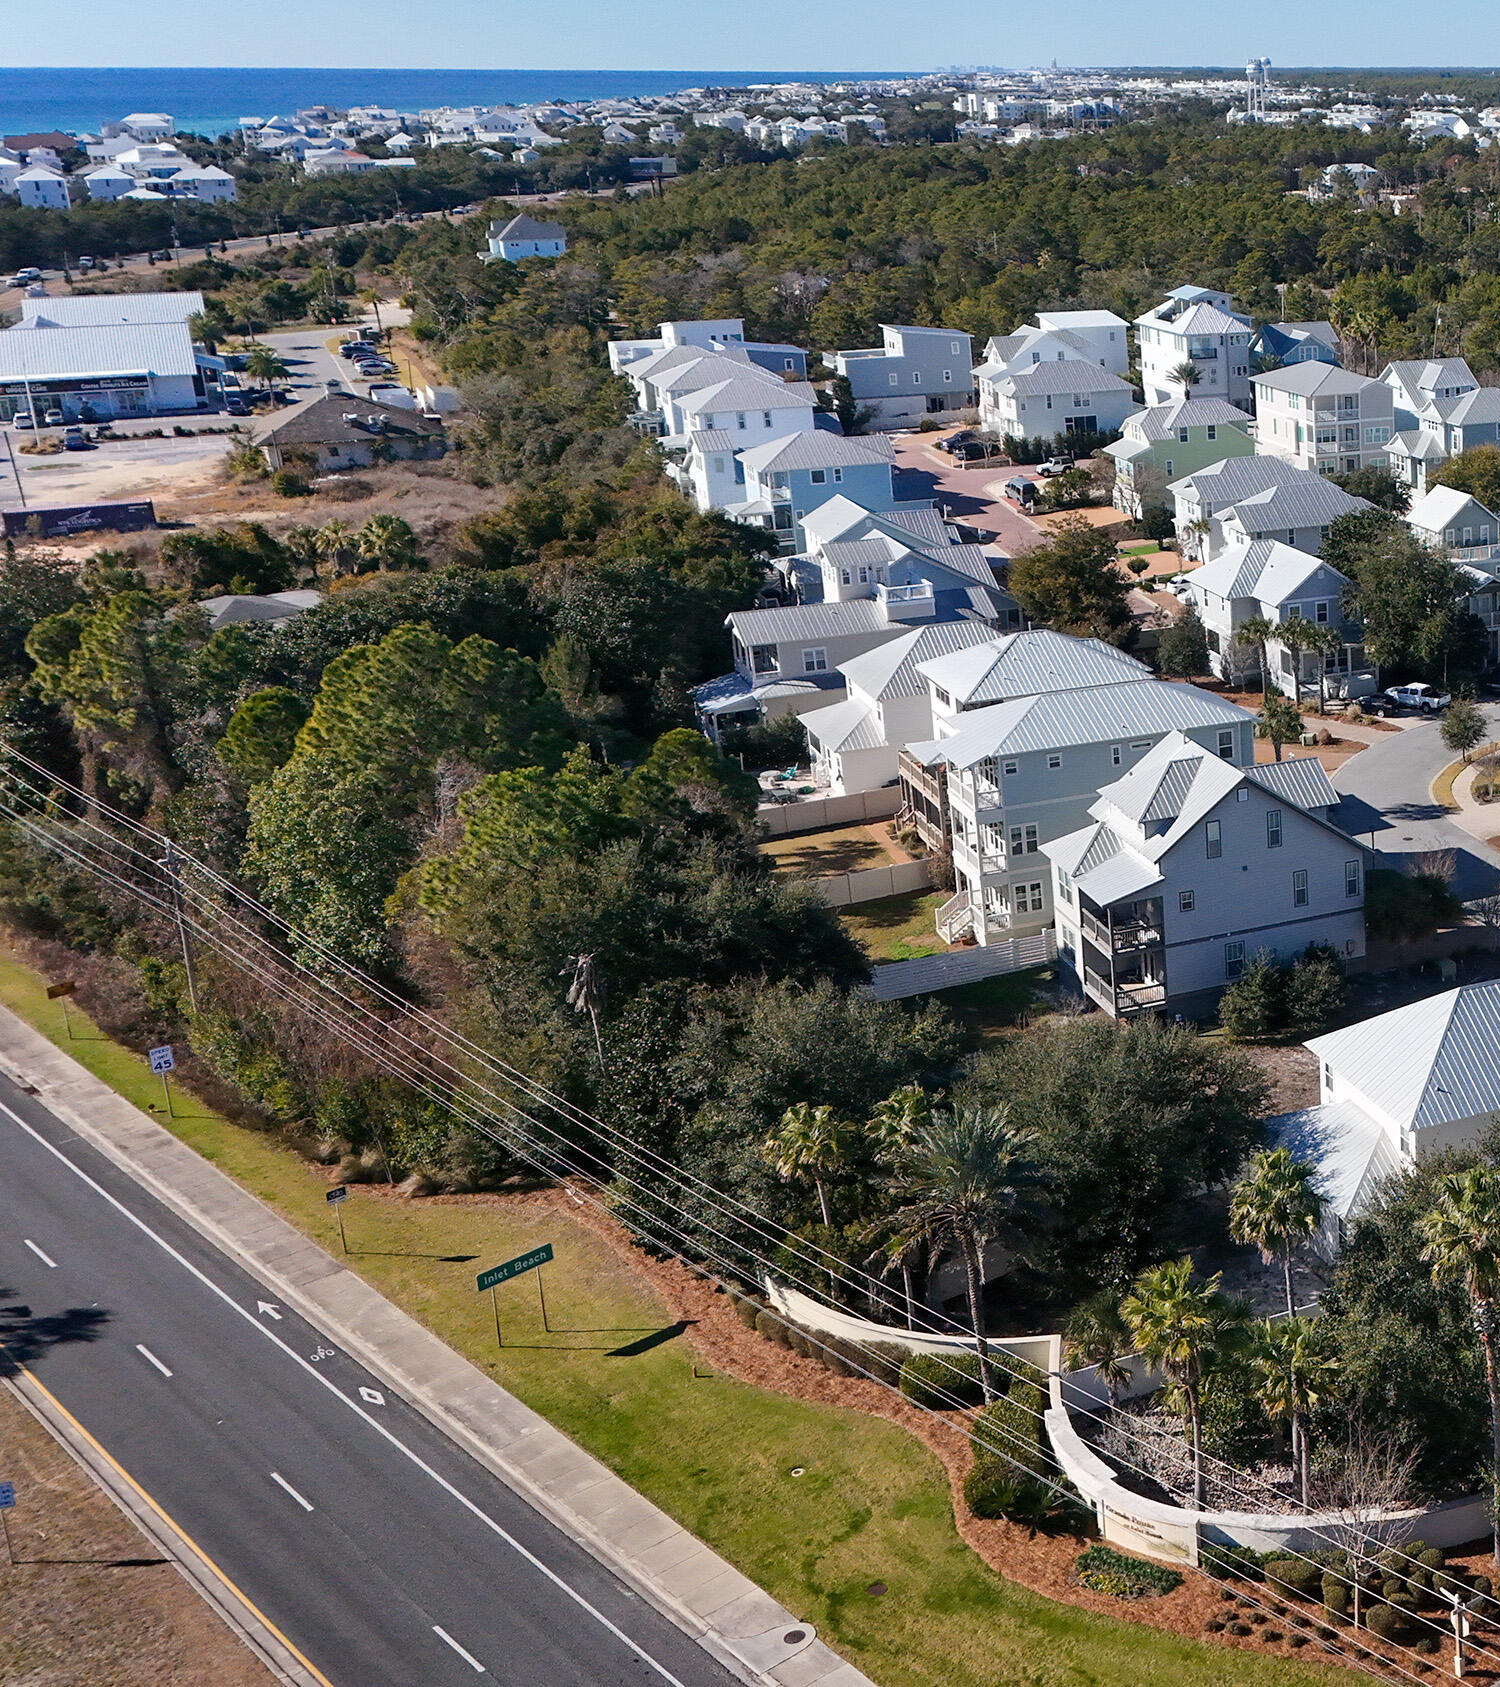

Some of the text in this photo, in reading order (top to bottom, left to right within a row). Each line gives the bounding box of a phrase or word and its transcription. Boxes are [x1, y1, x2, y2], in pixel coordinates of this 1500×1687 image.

[154, 1059, 172, 1070] 45
[483, 1252, 547, 1284] Inlet Beach
